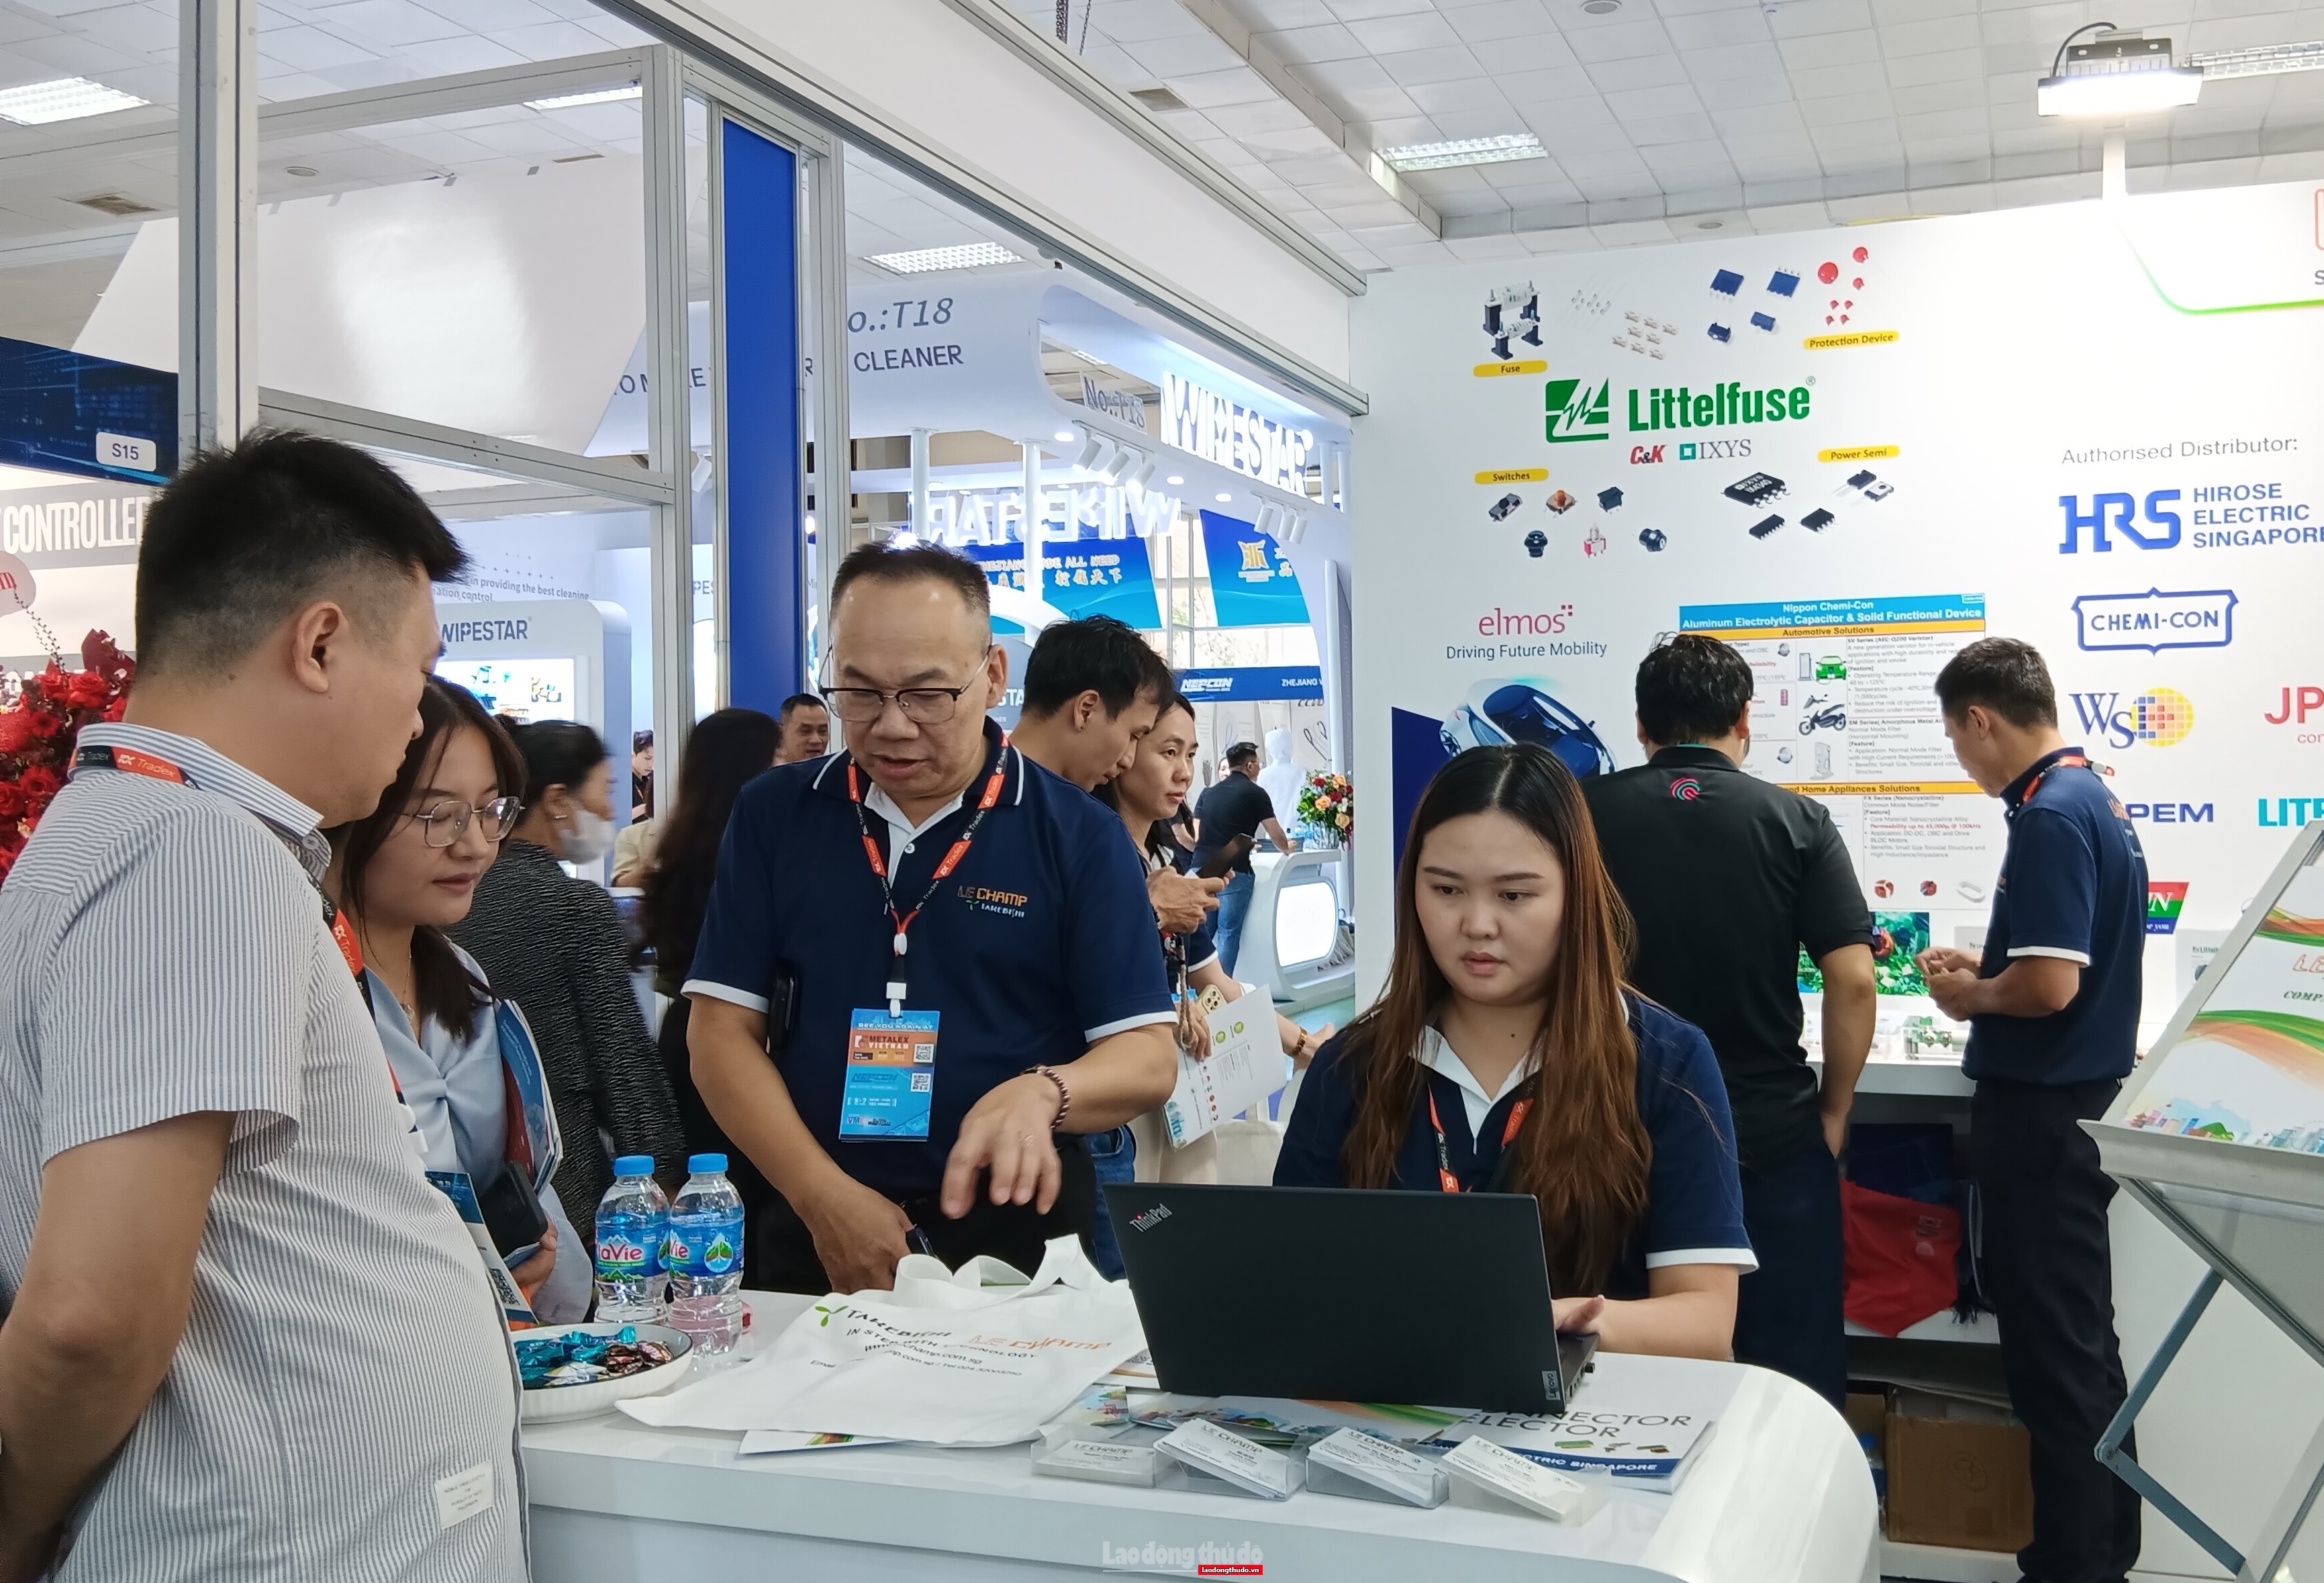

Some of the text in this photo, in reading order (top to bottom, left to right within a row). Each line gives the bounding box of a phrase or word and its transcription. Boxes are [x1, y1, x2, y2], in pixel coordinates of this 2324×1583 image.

[1810, 334, 1893, 348] Protection Device
[853, 344, 964, 373] CLEANER
[1501, 365, 1520, 373] Fuse
[1628, 382, 1810, 432] Littelfuse
[111, 443, 139, 460] S15
[1630, 439, 1751, 465] C&K IXYS
[1831, 448, 1886, 460] Power Semi
[2062, 438, 2297, 464] Authorised Distributor:
[1493, 473, 1530, 481] Switches
[2193, 483, 2282, 503] HIROSE
[2059, 489, 2181, 554] HRS
[2194, 504, 2310, 525] ELECTRIC
[462, 591, 495, 602] control.
[481, 579, 589, 600] providing the best cleaning
[1783, 601, 1874, 614] Nippon Chemi-Con
[1479, 608, 1565, 636] elmos
[1682, 608, 1982, 629] Aluminum Electrolytic Capacitor & Solid Functional Device
[2091, 610, 2219, 631] CHEMI-CON
[1782, 626, 1874, 636] Automotive Solutions
[1447, 641, 1607, 661] Driving Future Mobility
[1181, 677, 1233, 691] NEPCON
[1281, 679, 1318, 687] ZHEJIANG
[138, 757, 177, 778] Tradex
[1829, 785, 1876, 795] Appliances
[969, 810, 985, 831] Tradex
[947, 844, 964, 865] Tradex
[977, 888, 1027, 906] CHAMP
[1129, 1203, 1173, 1233] ThinkPad
[969, 1335, 1112, 1349] LE CHAMP
[1218, 1433, 1263, 1453] CHAMP
